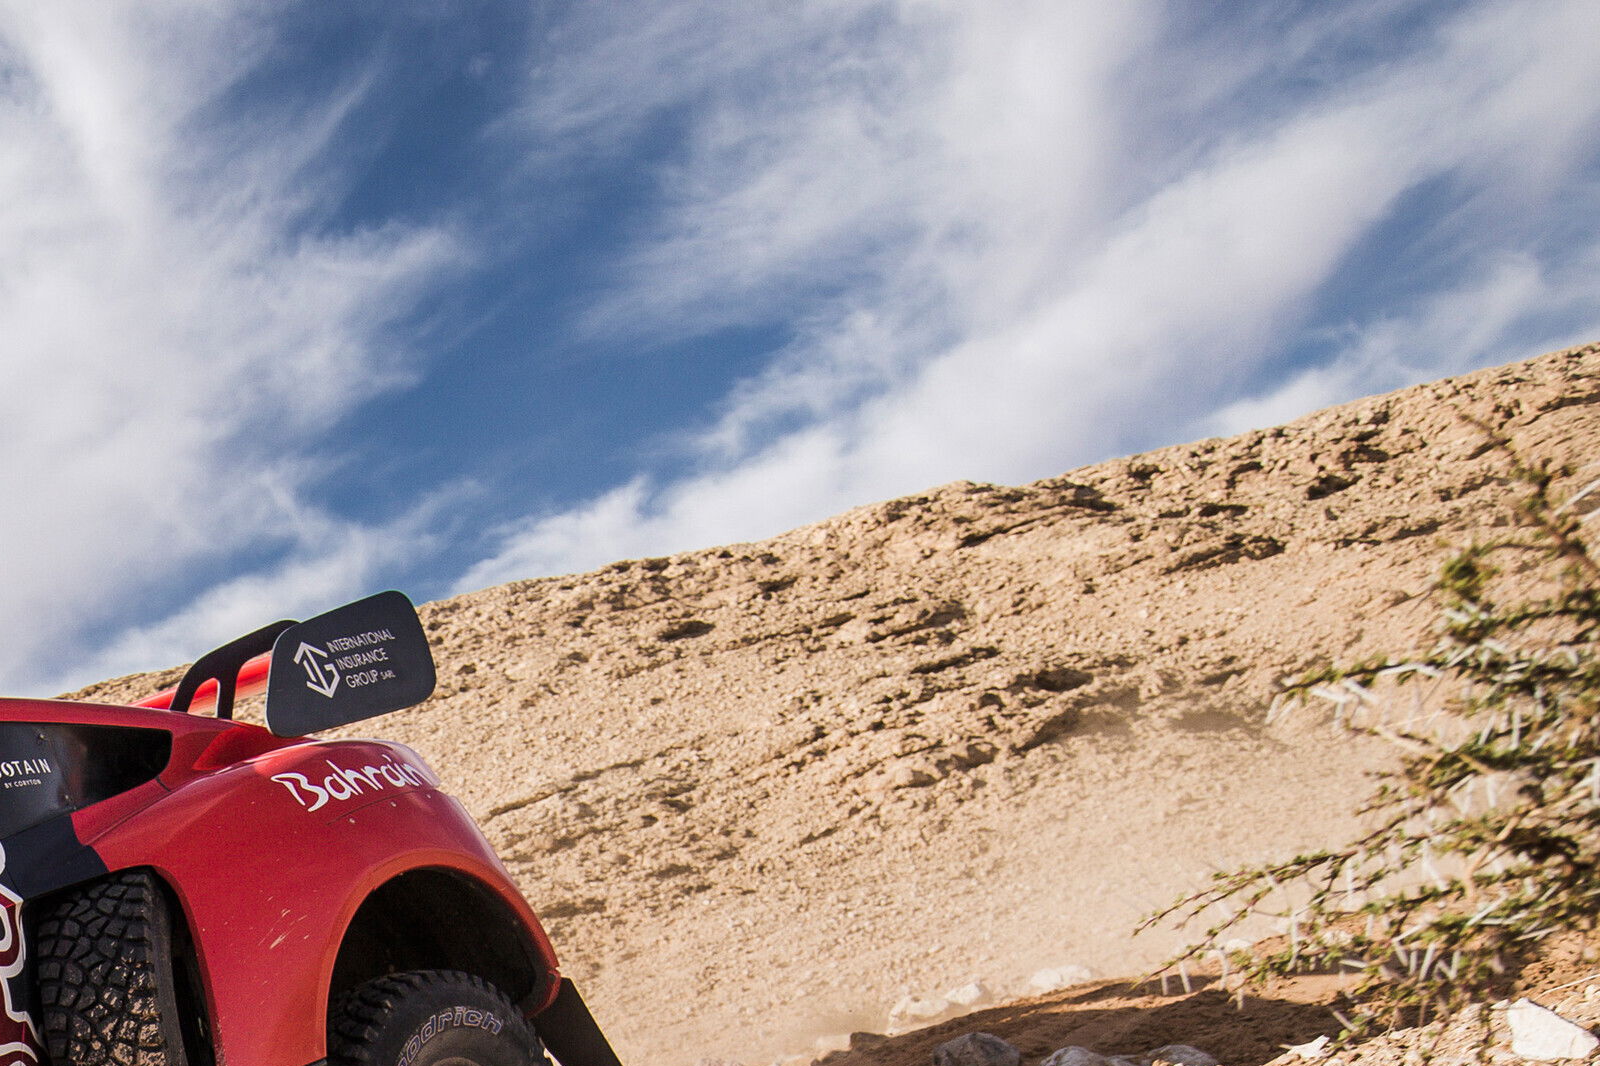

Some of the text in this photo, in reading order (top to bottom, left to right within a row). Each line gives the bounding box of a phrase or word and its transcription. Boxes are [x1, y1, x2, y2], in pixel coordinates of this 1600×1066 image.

[326, 628, 396, 653] INTERNATIONAL
[335, 647, 389, 670] INSURANCE
[345, 670, 379, 688] GROUP
[270, 754, 435, 812] Bahrain
